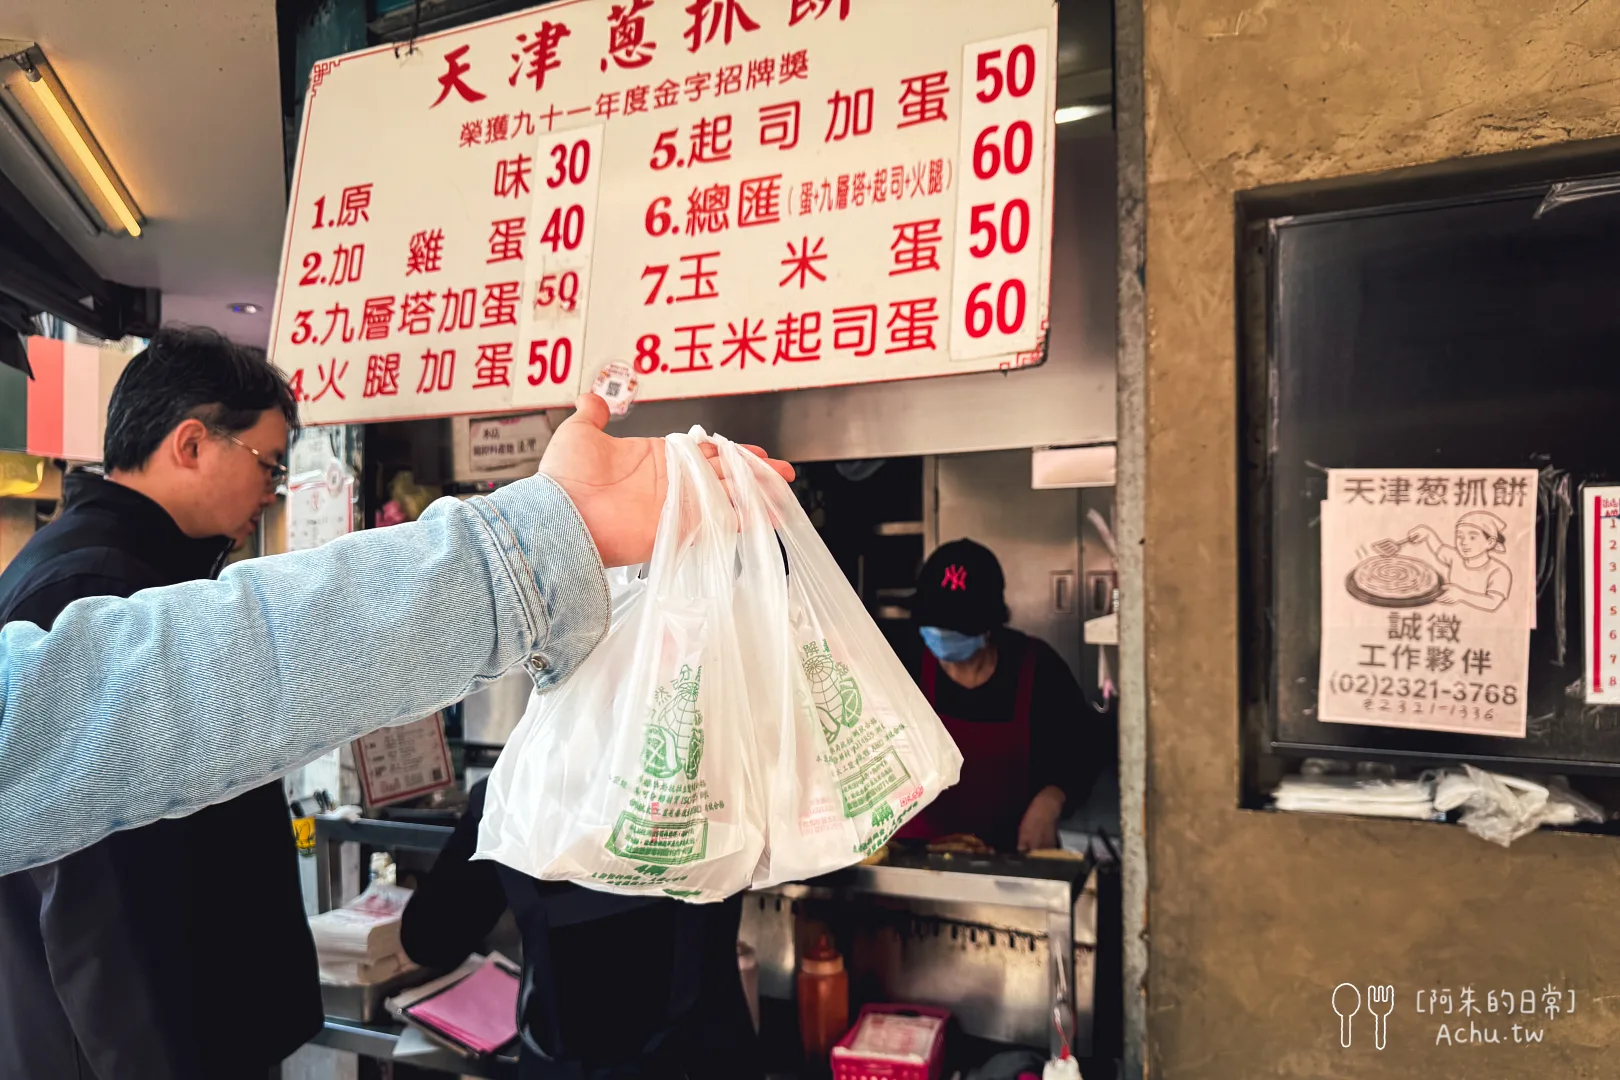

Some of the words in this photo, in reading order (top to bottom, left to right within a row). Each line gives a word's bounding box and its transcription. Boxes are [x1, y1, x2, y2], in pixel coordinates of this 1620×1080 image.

[975, 43, 1037, 104] 50
[546, 139, 591, 189] 30
[972, 120, 1033, 180] 60
[539, 203, 585, 253] 40
[968, 198, 1030, 259] 50
[290, 280, 520, 346] 3.九層塔加蛋
[537, 270, 579, 312] 50
[633, 297, 940, 375] 8.玉米起司蛋
[963, 278, 1026, 340] 60
[527, 336, 572, 386] 50
[1387, 611, 1462, 643] 誠徵
[1358, 644, 1492, 676] 工作夥伴
[1329, 671, 1518, 706] (02)2321-3768
